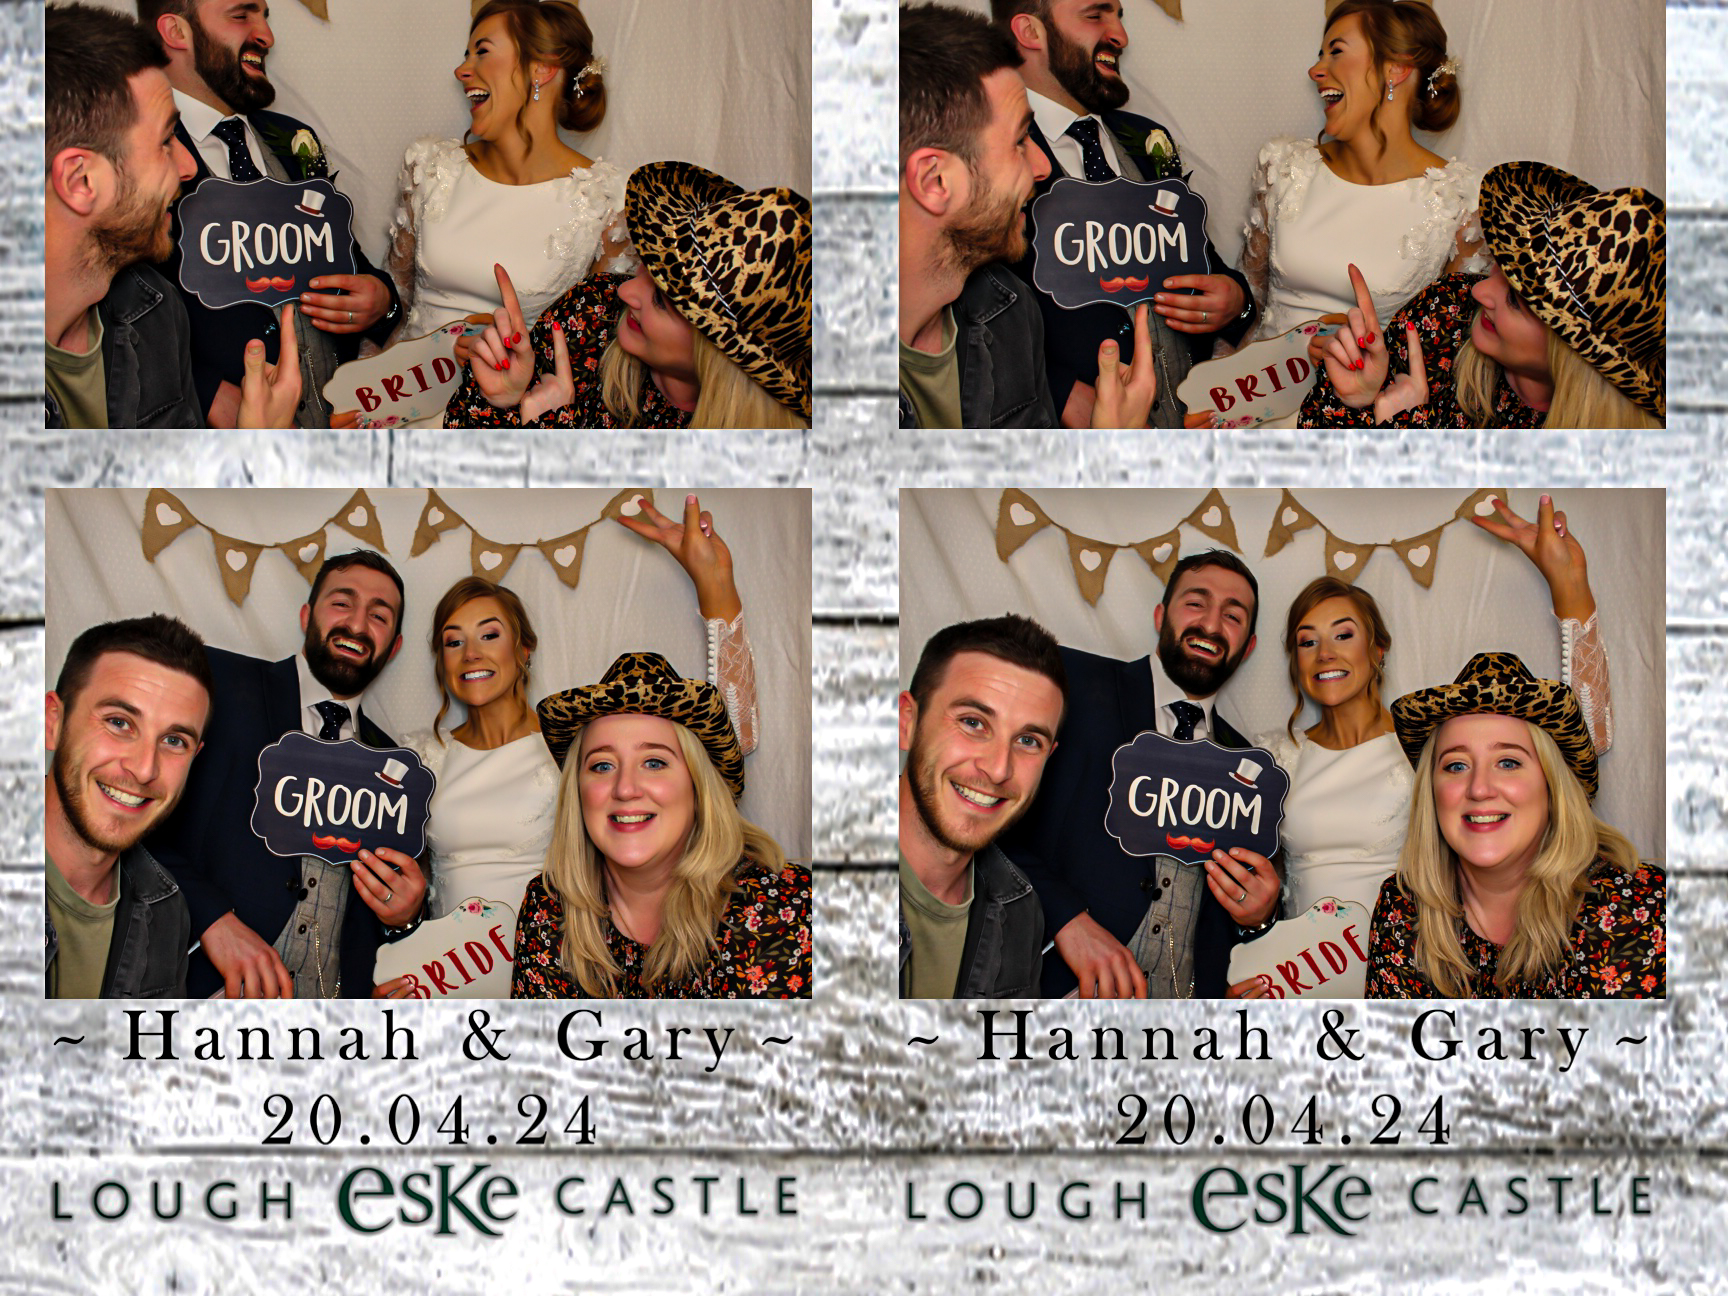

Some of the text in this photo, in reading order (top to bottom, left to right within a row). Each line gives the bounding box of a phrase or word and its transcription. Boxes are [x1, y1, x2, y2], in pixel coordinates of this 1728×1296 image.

[200, 221, 335, 272] GROOM
[1054, 221, 1189, 272] GROOM
[355, 357, 457, 413] BRID
[1209, 357, 1311, 413] BRID
[274, 775, 408, 834] GROOM
[1128, 775, 1262, 834] GROOM
